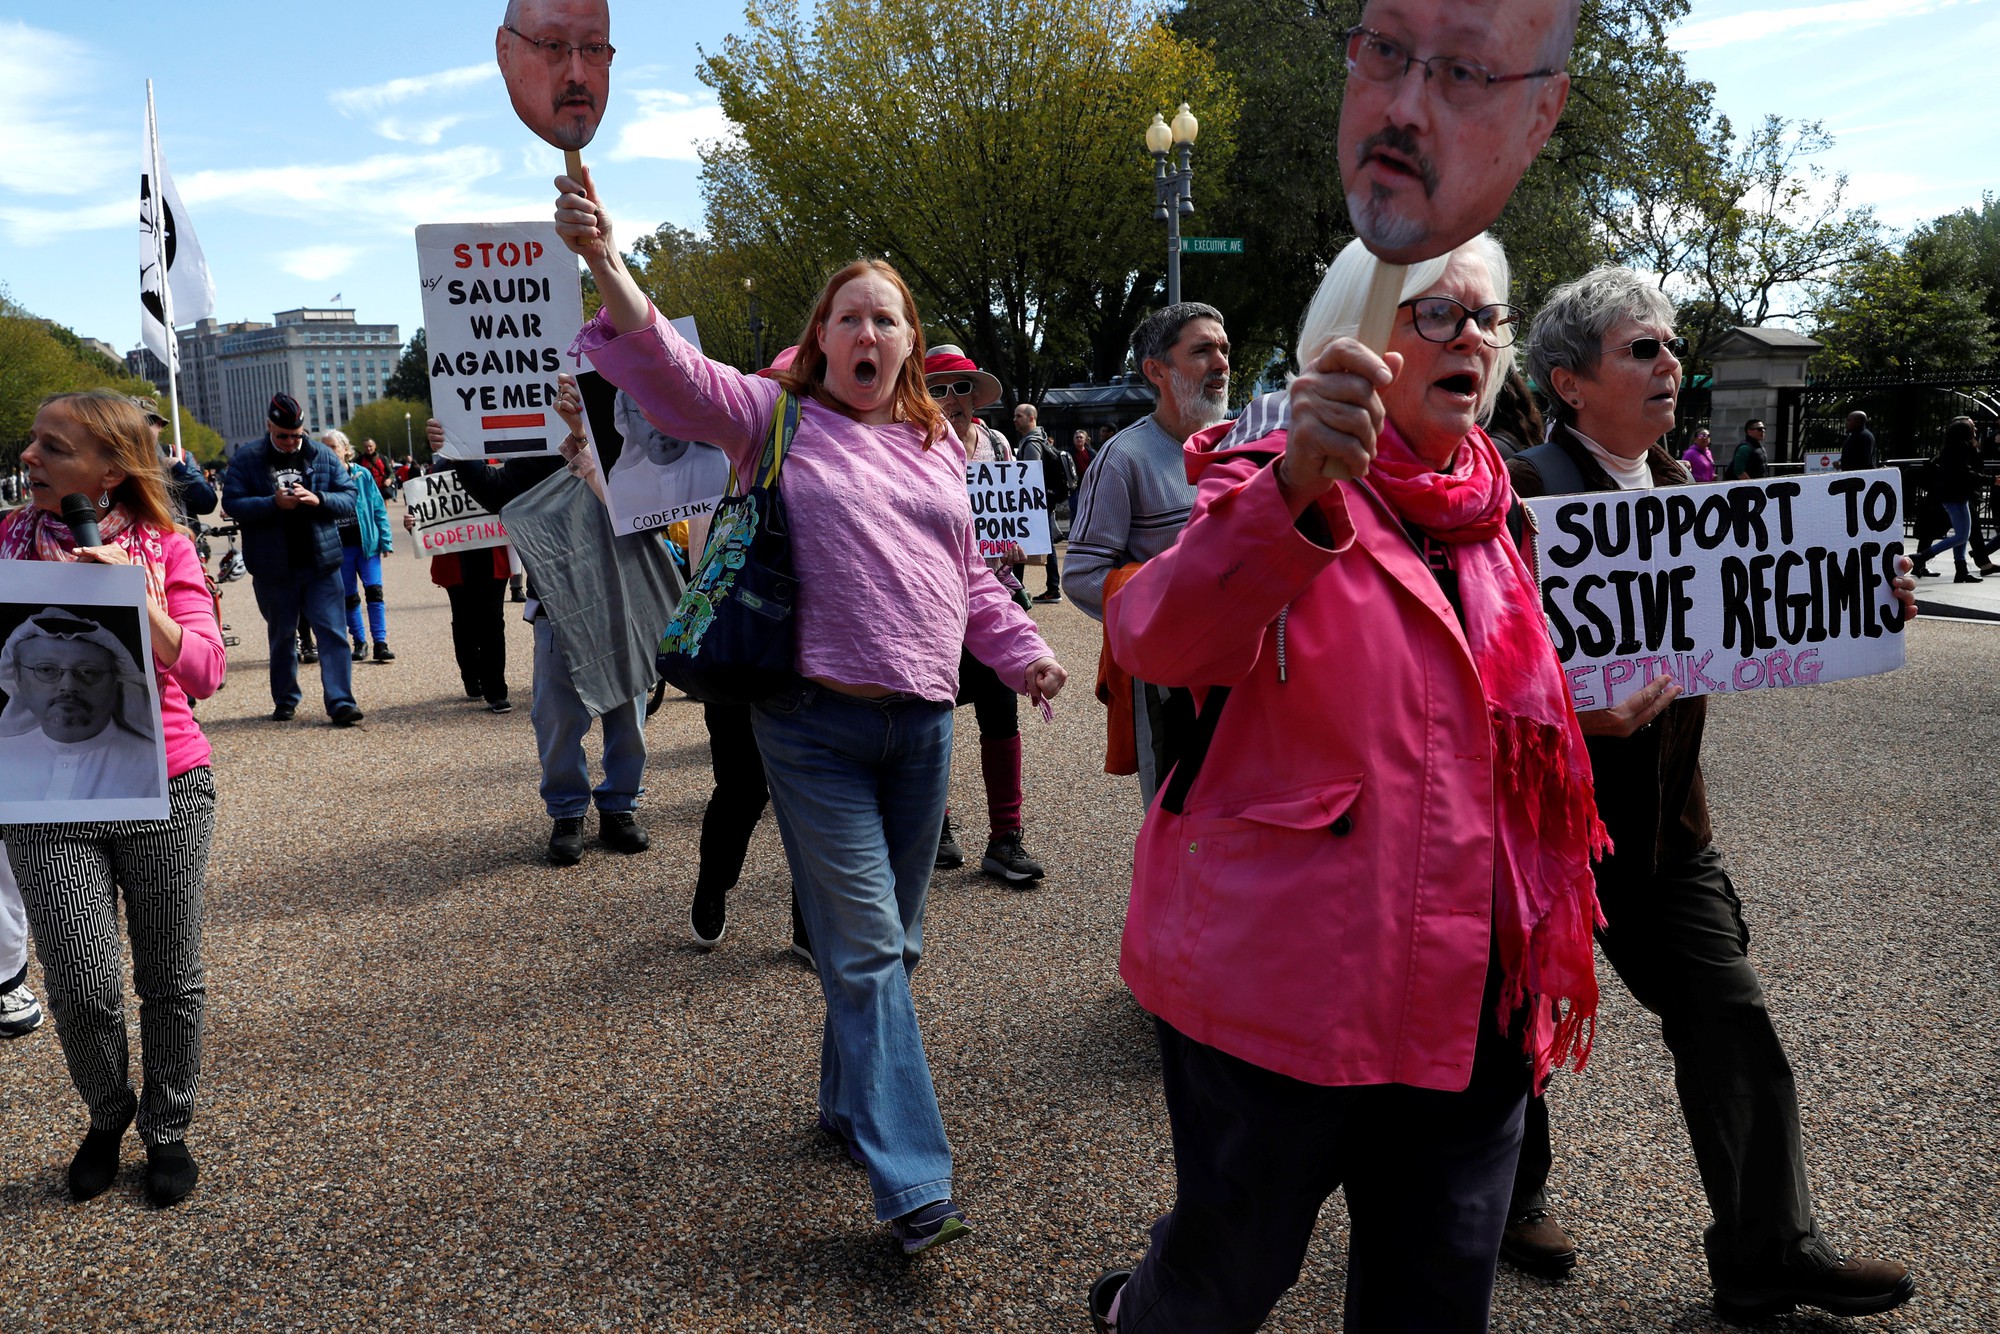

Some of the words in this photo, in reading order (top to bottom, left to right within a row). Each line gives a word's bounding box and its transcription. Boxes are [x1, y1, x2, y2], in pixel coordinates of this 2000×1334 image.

[453, 241, 544, 269] STOP
[1194, 240, 1227, 251] EXECUTIVE
[1229, 240, 1242, 252] AVE
[448, 277, 551, 305] SAUDI
[470, 313, 542, 340] WAR
[431, 347, 561, 378] AGAINS
[456, 382, 558, 411] YEMEN
[966, 462, 1028, 486] EAT?
[408, 492, 477, 523] MURDE
[970, 486, 1047, 515] UCLEAR
[632, 502, 713, 531] CODEPINK
[974, 516, 1031, 540] PONS
[1547, 481, 1801, 569] SUPPORT
[1828, 477, 1898, 538] TO
[422, 521, 509, 550] CODEPINK
[1541, 565, 1696, 664] SSIVE
[1721, 541, 1905, 658] REGIMES
[1565, 648, 1824, 710] EPINK.ORG
